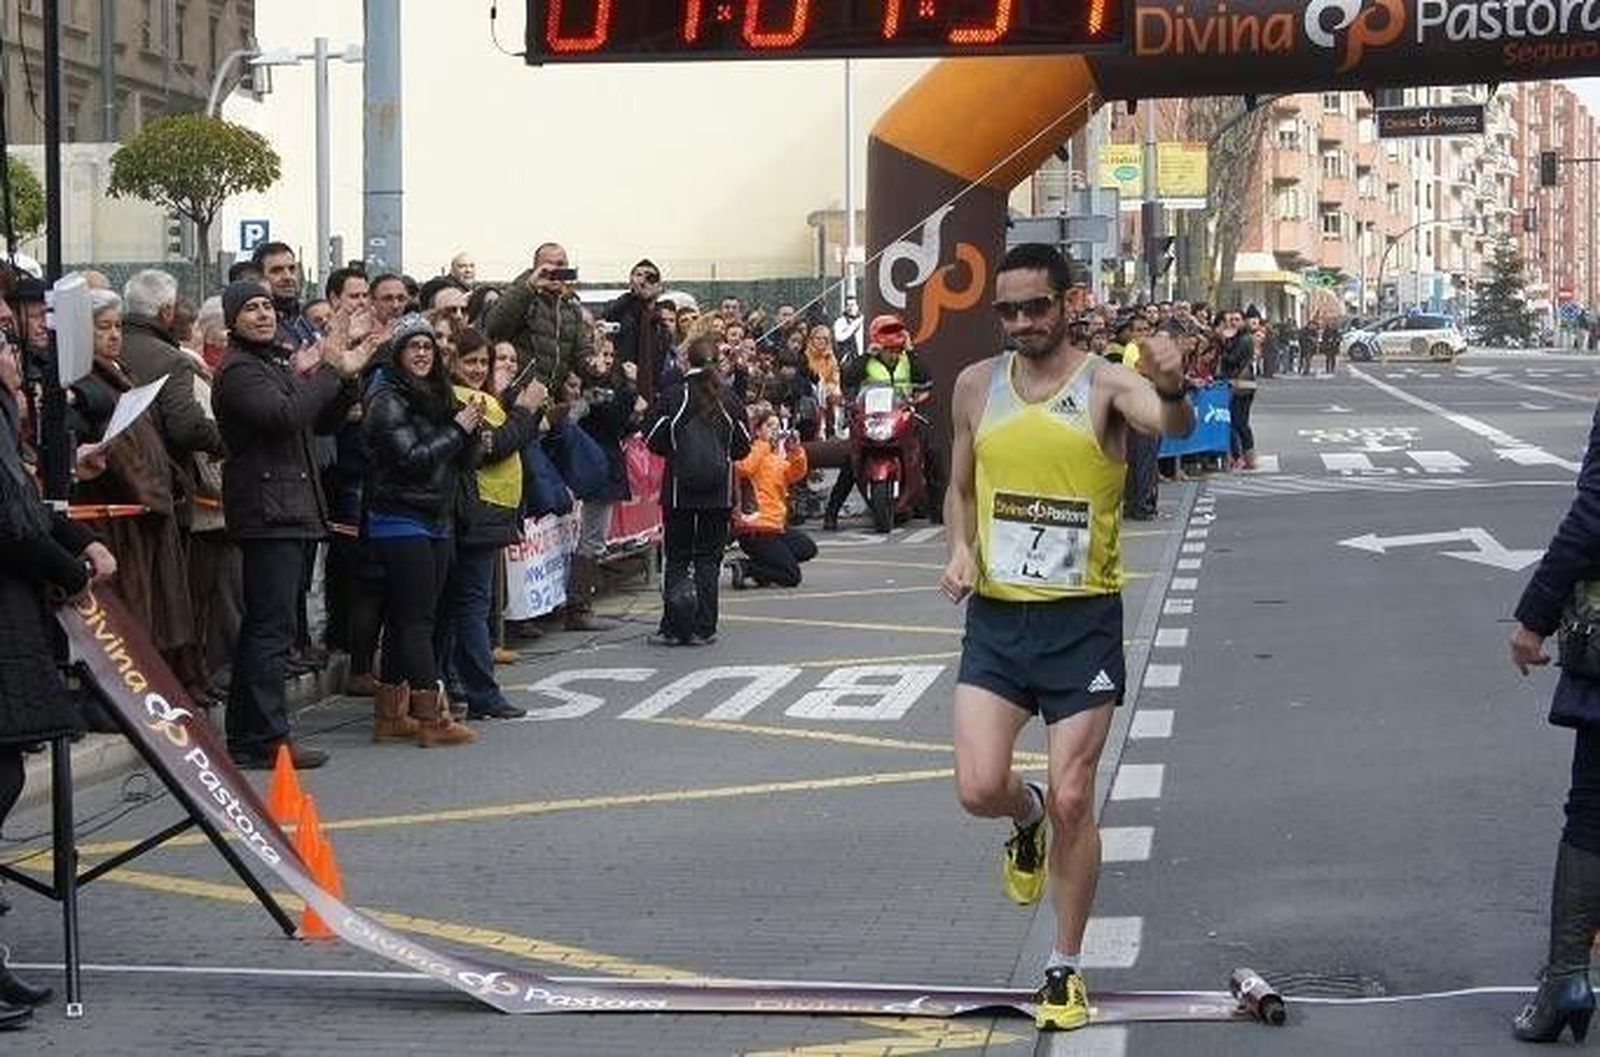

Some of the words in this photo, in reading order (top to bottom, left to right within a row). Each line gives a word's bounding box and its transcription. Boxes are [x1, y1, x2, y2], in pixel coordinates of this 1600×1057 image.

[1136, 3, 1294, 55] Divina
[245, 224, 265, 248] P
[1047, 506, 1088, 523] Pastora
[1030, 525, 1046, 550] 7
[502, 664, 947, 722] BUS
[184, 747, 282, 865] Pastora
[524, 987, 669, 1010] Pastora
